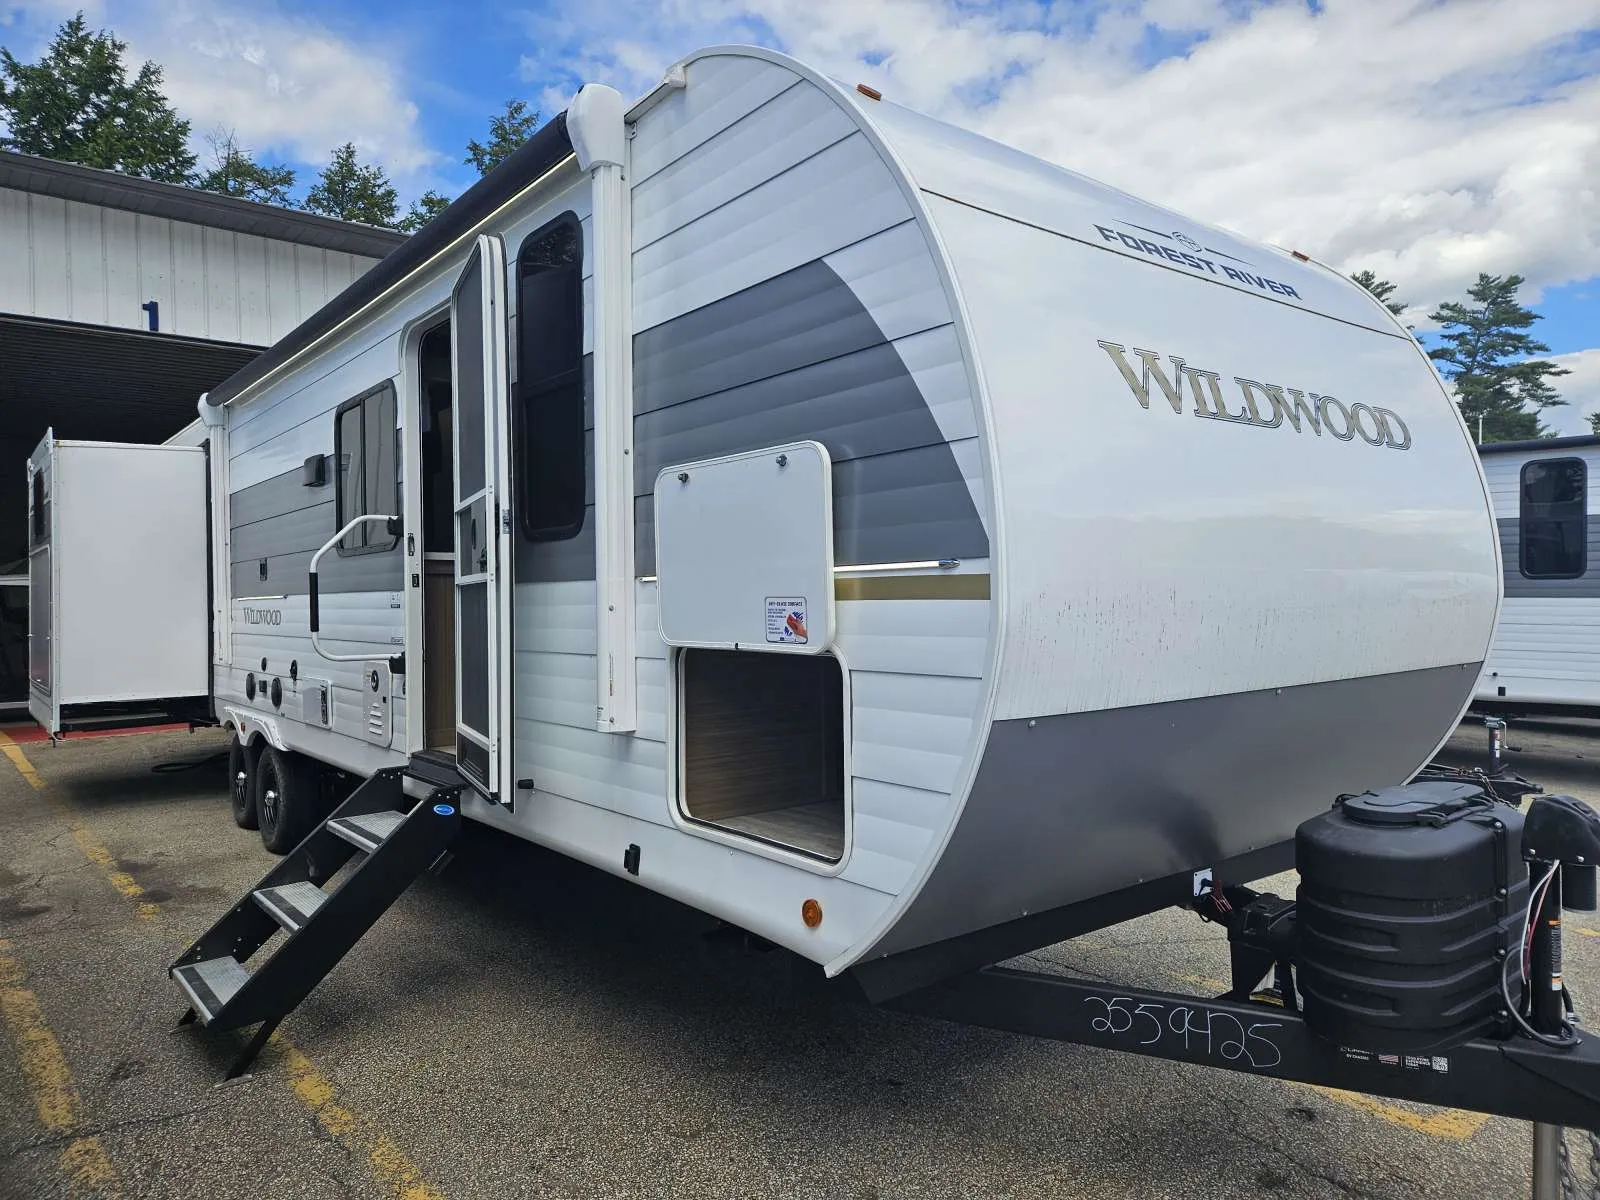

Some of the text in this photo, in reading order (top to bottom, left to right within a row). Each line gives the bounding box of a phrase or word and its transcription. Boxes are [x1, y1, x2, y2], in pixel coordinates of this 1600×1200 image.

[1093, 224, 1303, 300] FOREST RIVER
[142, 300, 159, 331] 1
[1097, 339, 1412, 450] WILDWOOD
[243, 607, 282, 626] WILDWOOD
[1084, 996, 1283, 1068] 2559425
